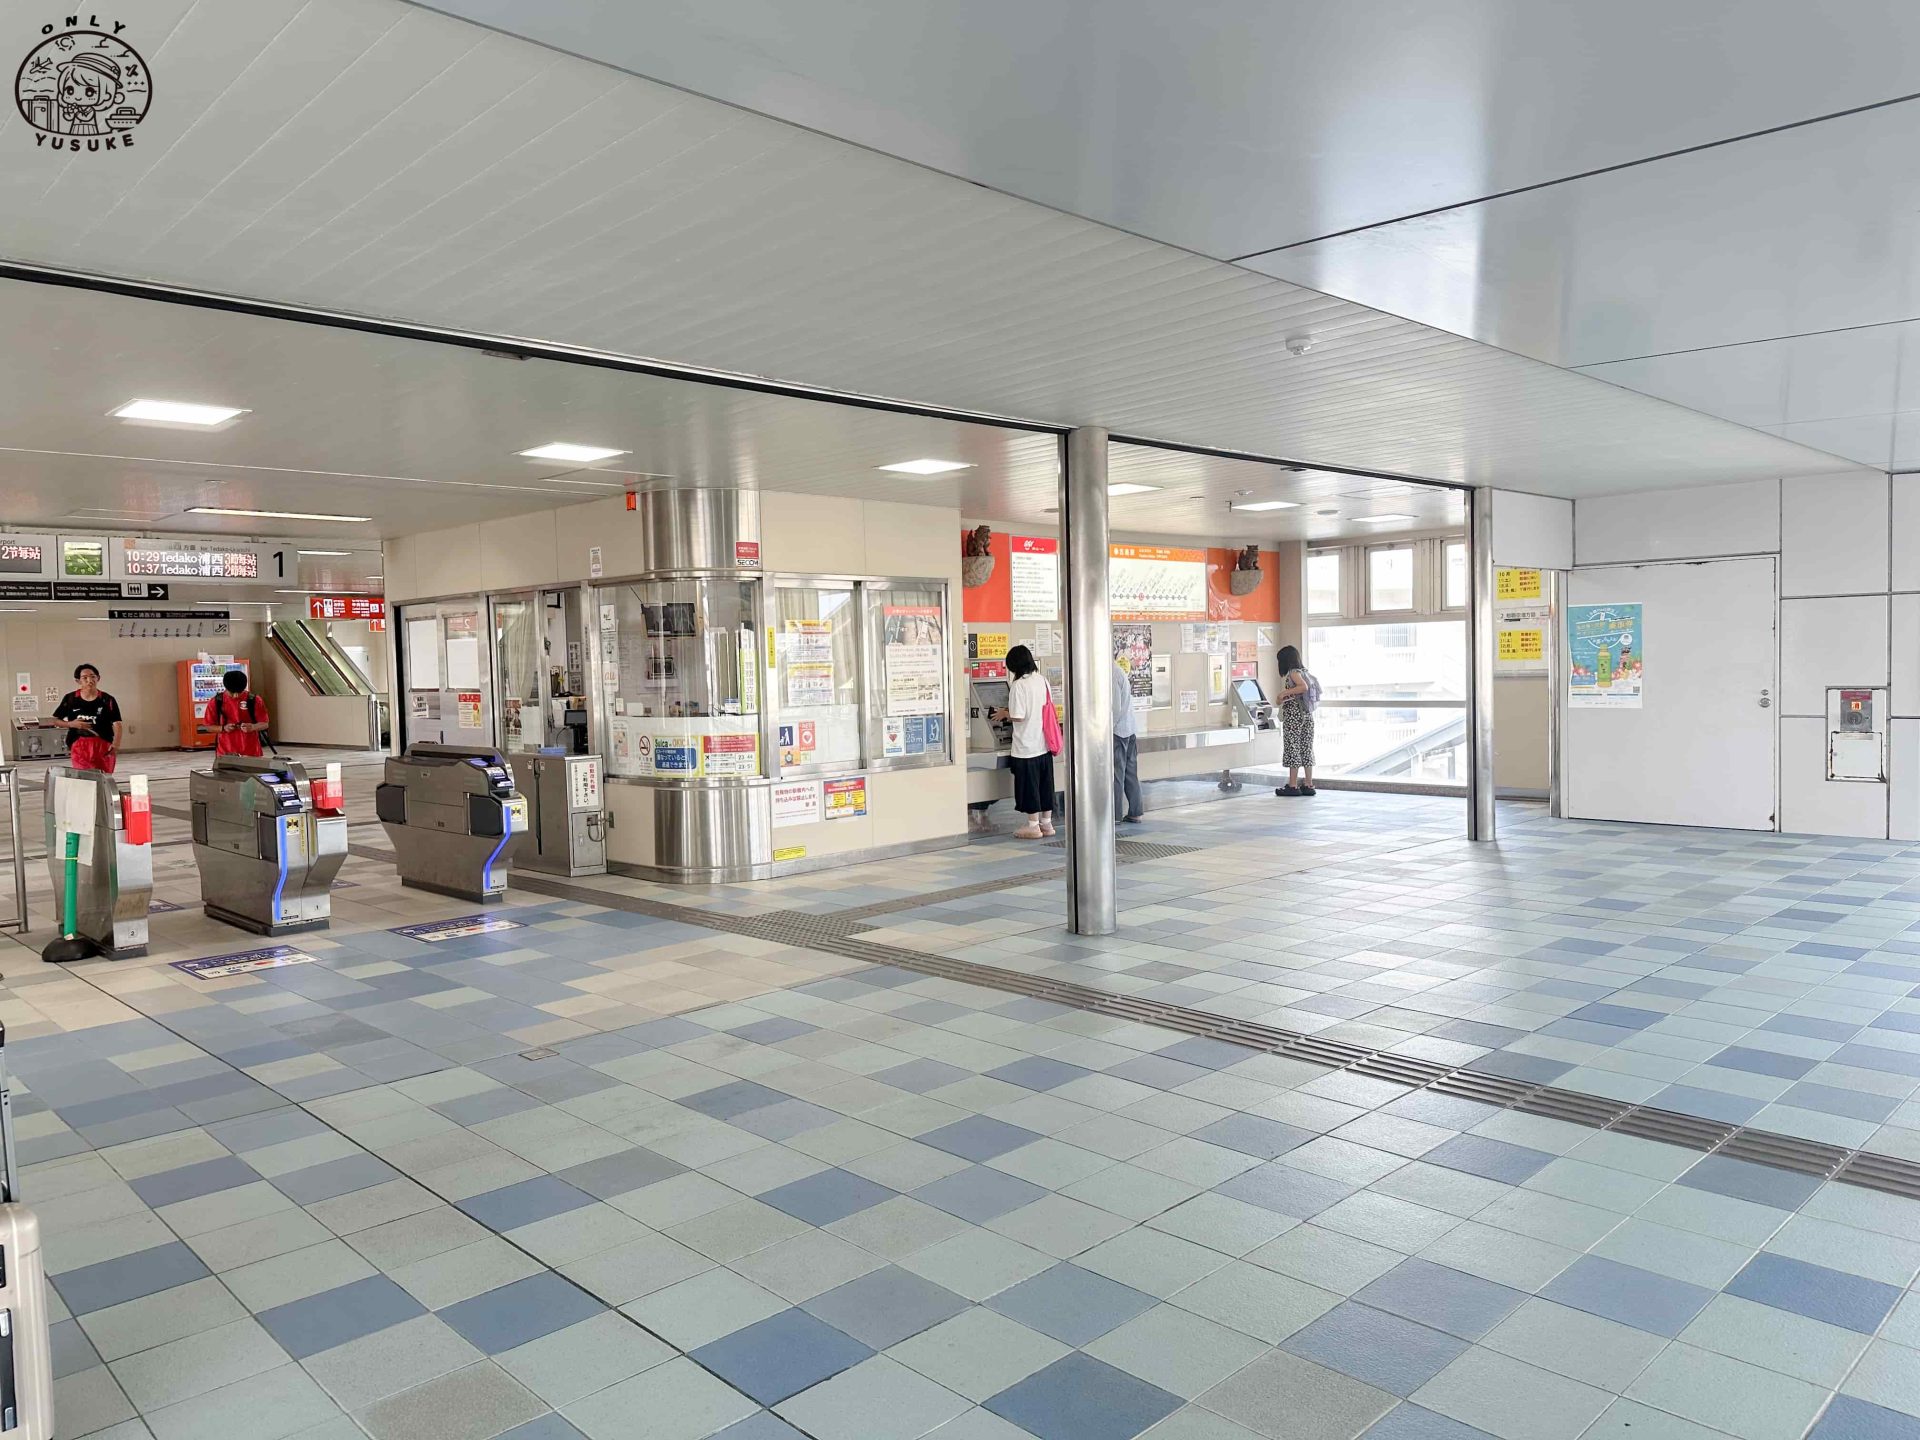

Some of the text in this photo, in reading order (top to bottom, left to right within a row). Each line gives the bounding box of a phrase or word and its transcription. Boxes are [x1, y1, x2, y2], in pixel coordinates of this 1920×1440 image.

[126, 551, 160, 562] 10:29
[127, 562, 160, 574] 10:37
[272, 551, 284, 578] 1
[655, 738, 668, 748] Suica
